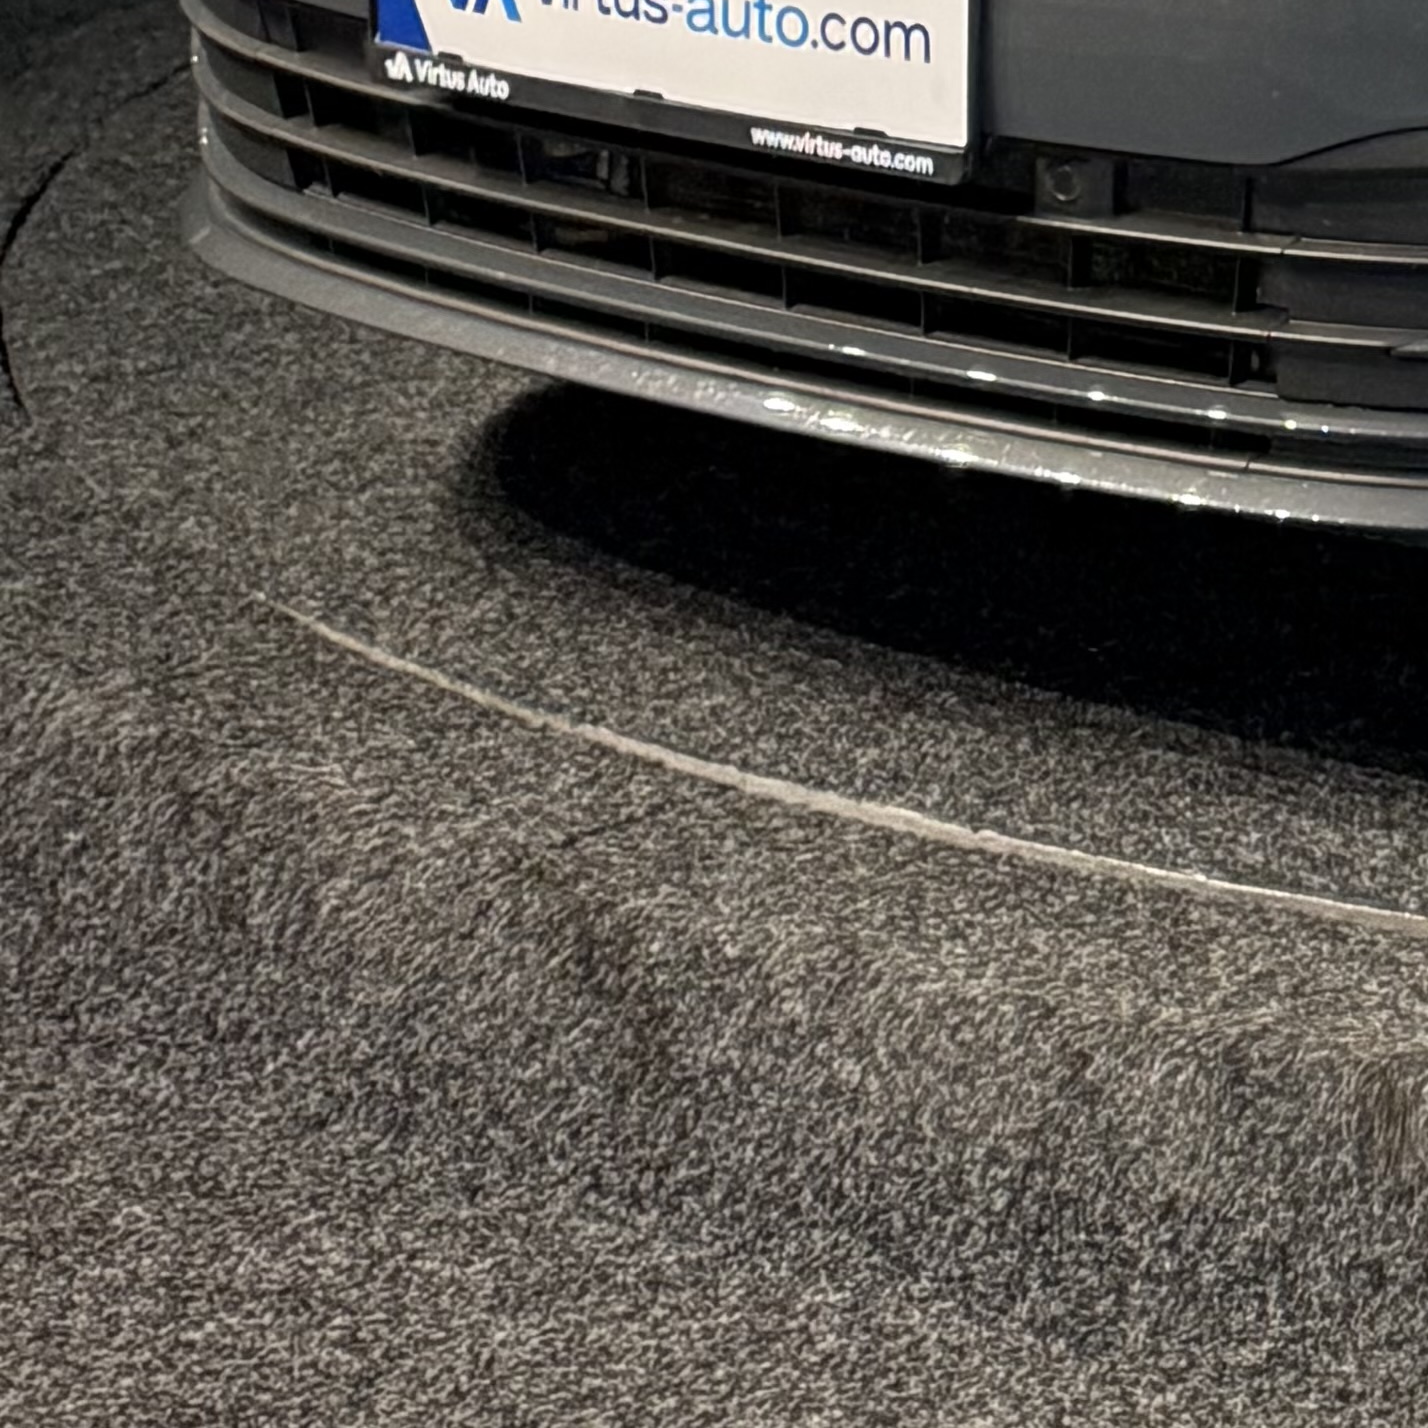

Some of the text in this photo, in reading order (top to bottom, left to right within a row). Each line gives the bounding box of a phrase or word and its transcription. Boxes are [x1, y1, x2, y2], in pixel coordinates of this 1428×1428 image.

[414, 58, 465, 92] Virtus
[467, 68, 510, 100] Auto
[750, 129, 935, 176] www.virtus-auto.com
